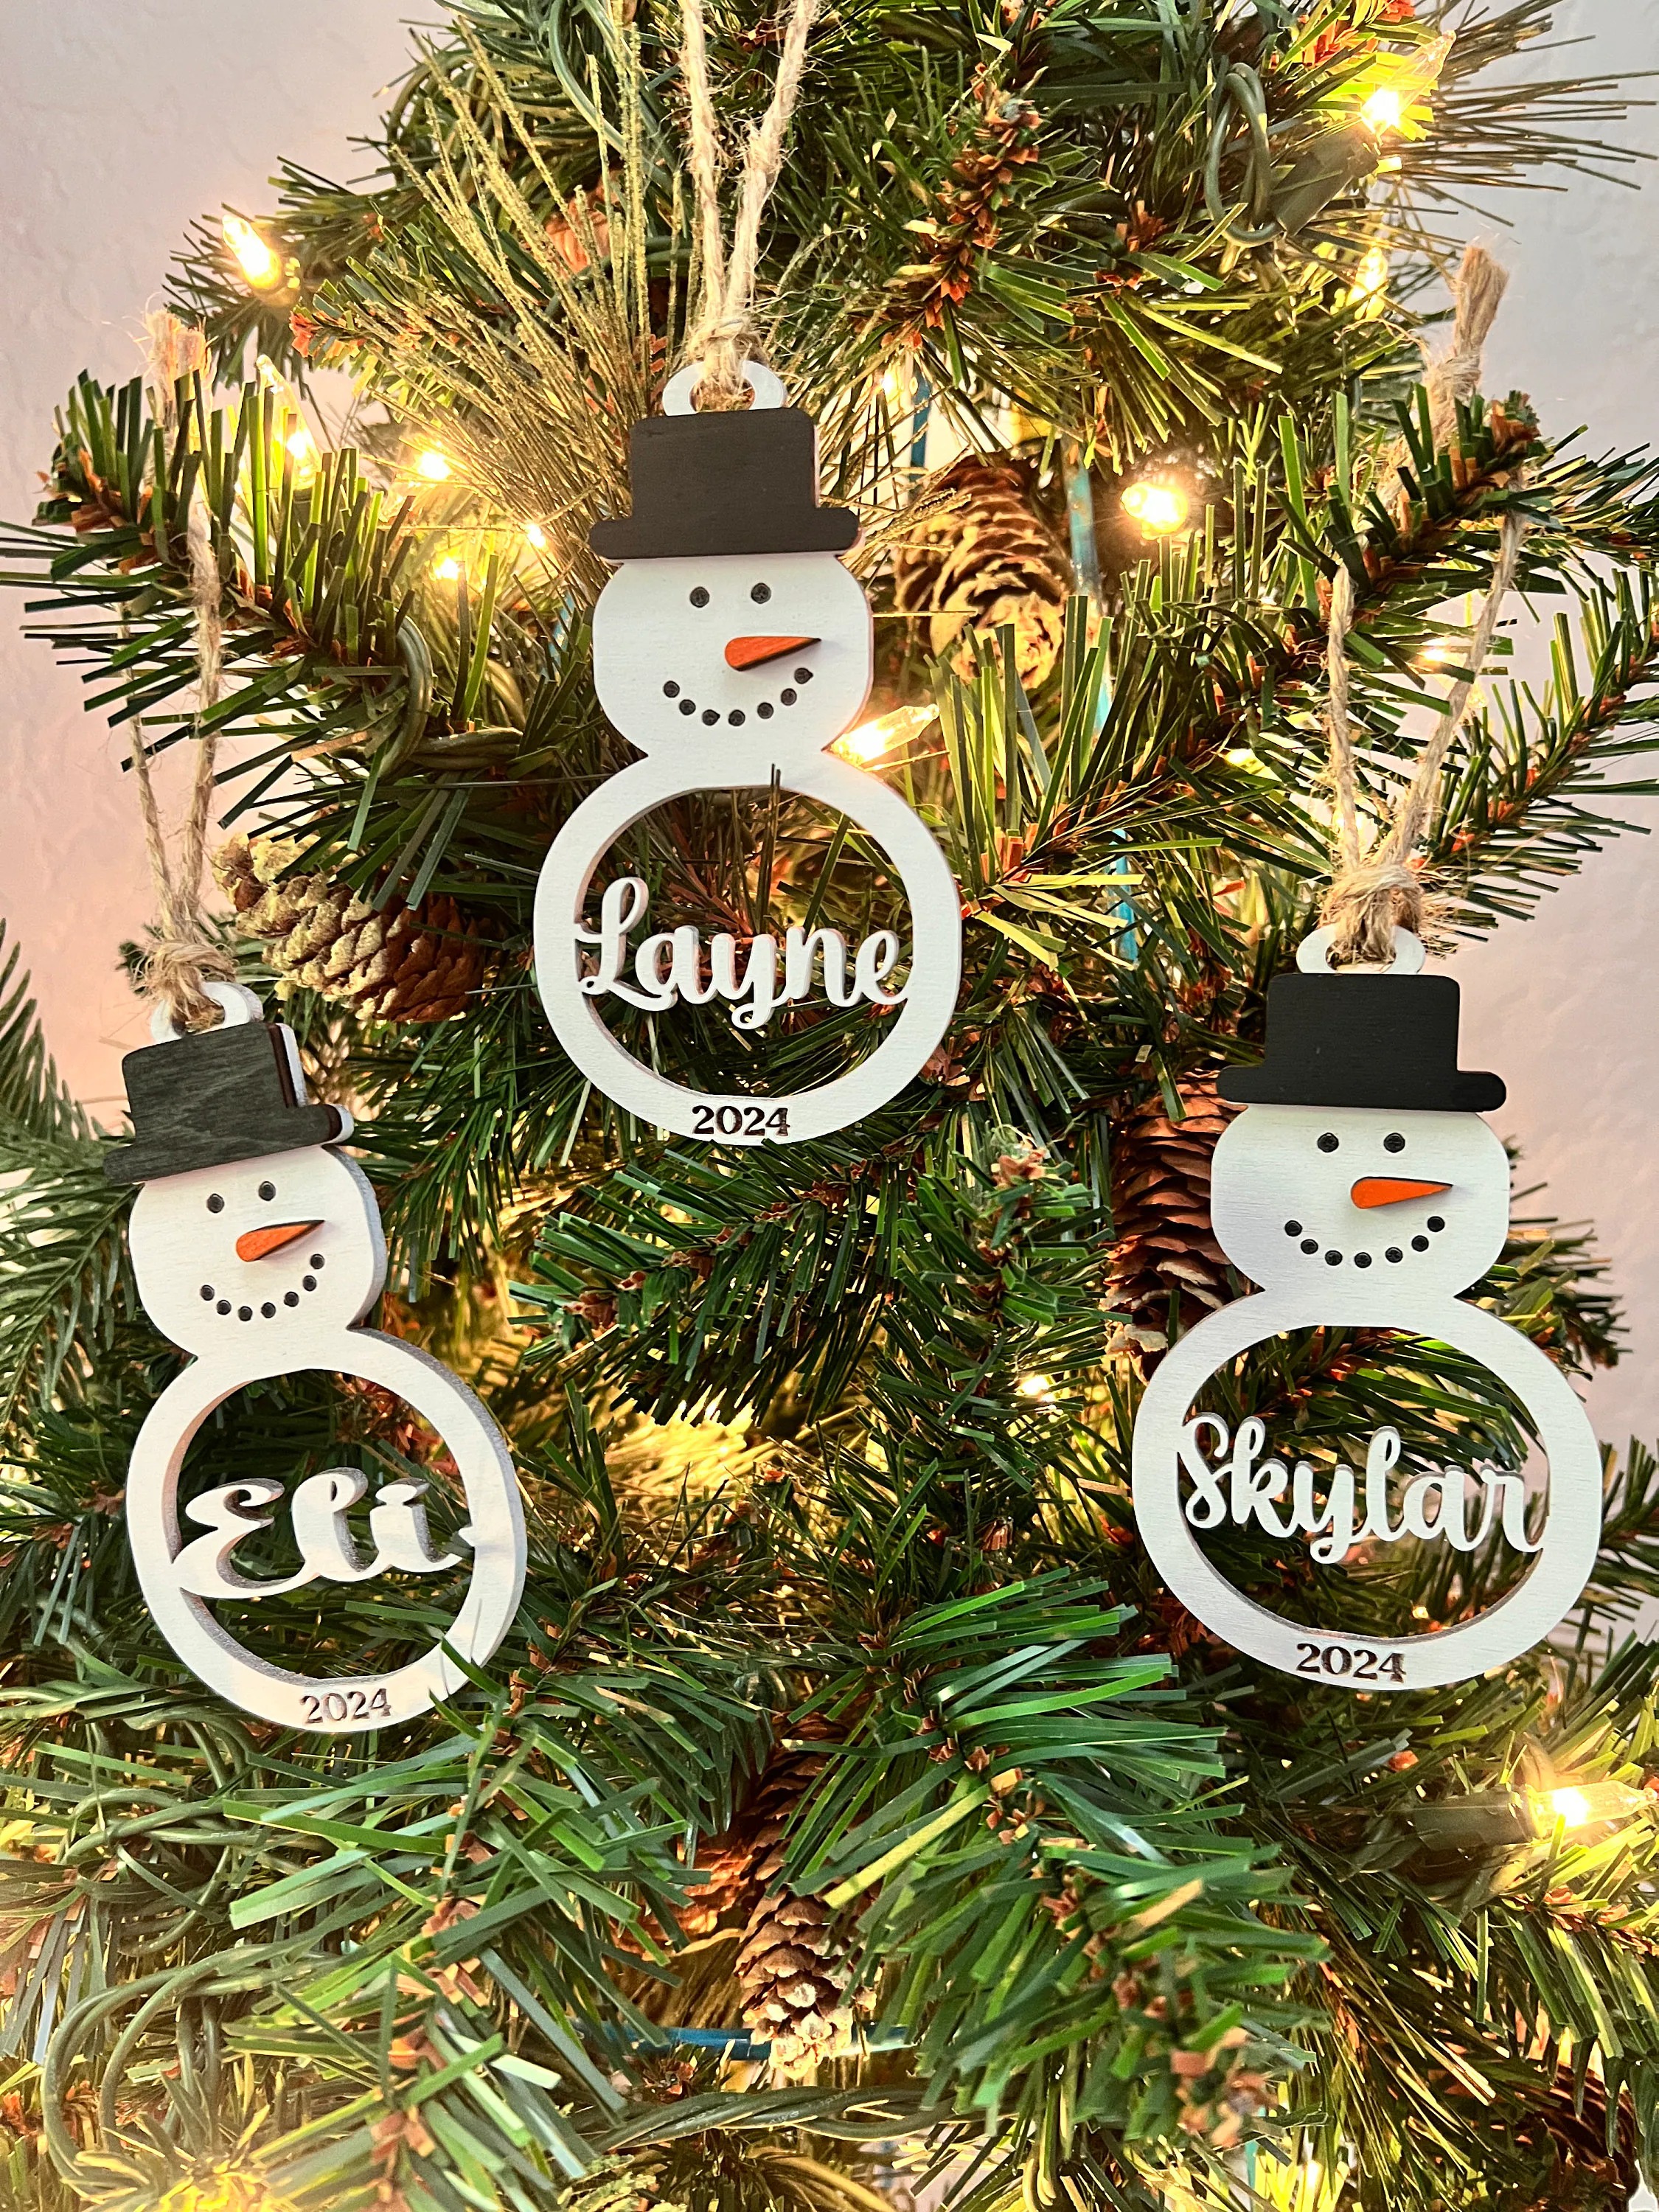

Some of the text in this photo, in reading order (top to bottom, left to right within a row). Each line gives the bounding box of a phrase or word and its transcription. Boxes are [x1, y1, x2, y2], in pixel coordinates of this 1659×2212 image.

[576, 877, 912, 1029] Layne
[691, 1105, 791, 1138] 2024
[1180, 1412, 1543, 1565] Skylar
[173, 1467, 467, 1599] Eli
[299, 1687, 392, 1725] 2024
[1295, 1642, 1408, 1684] 2024
